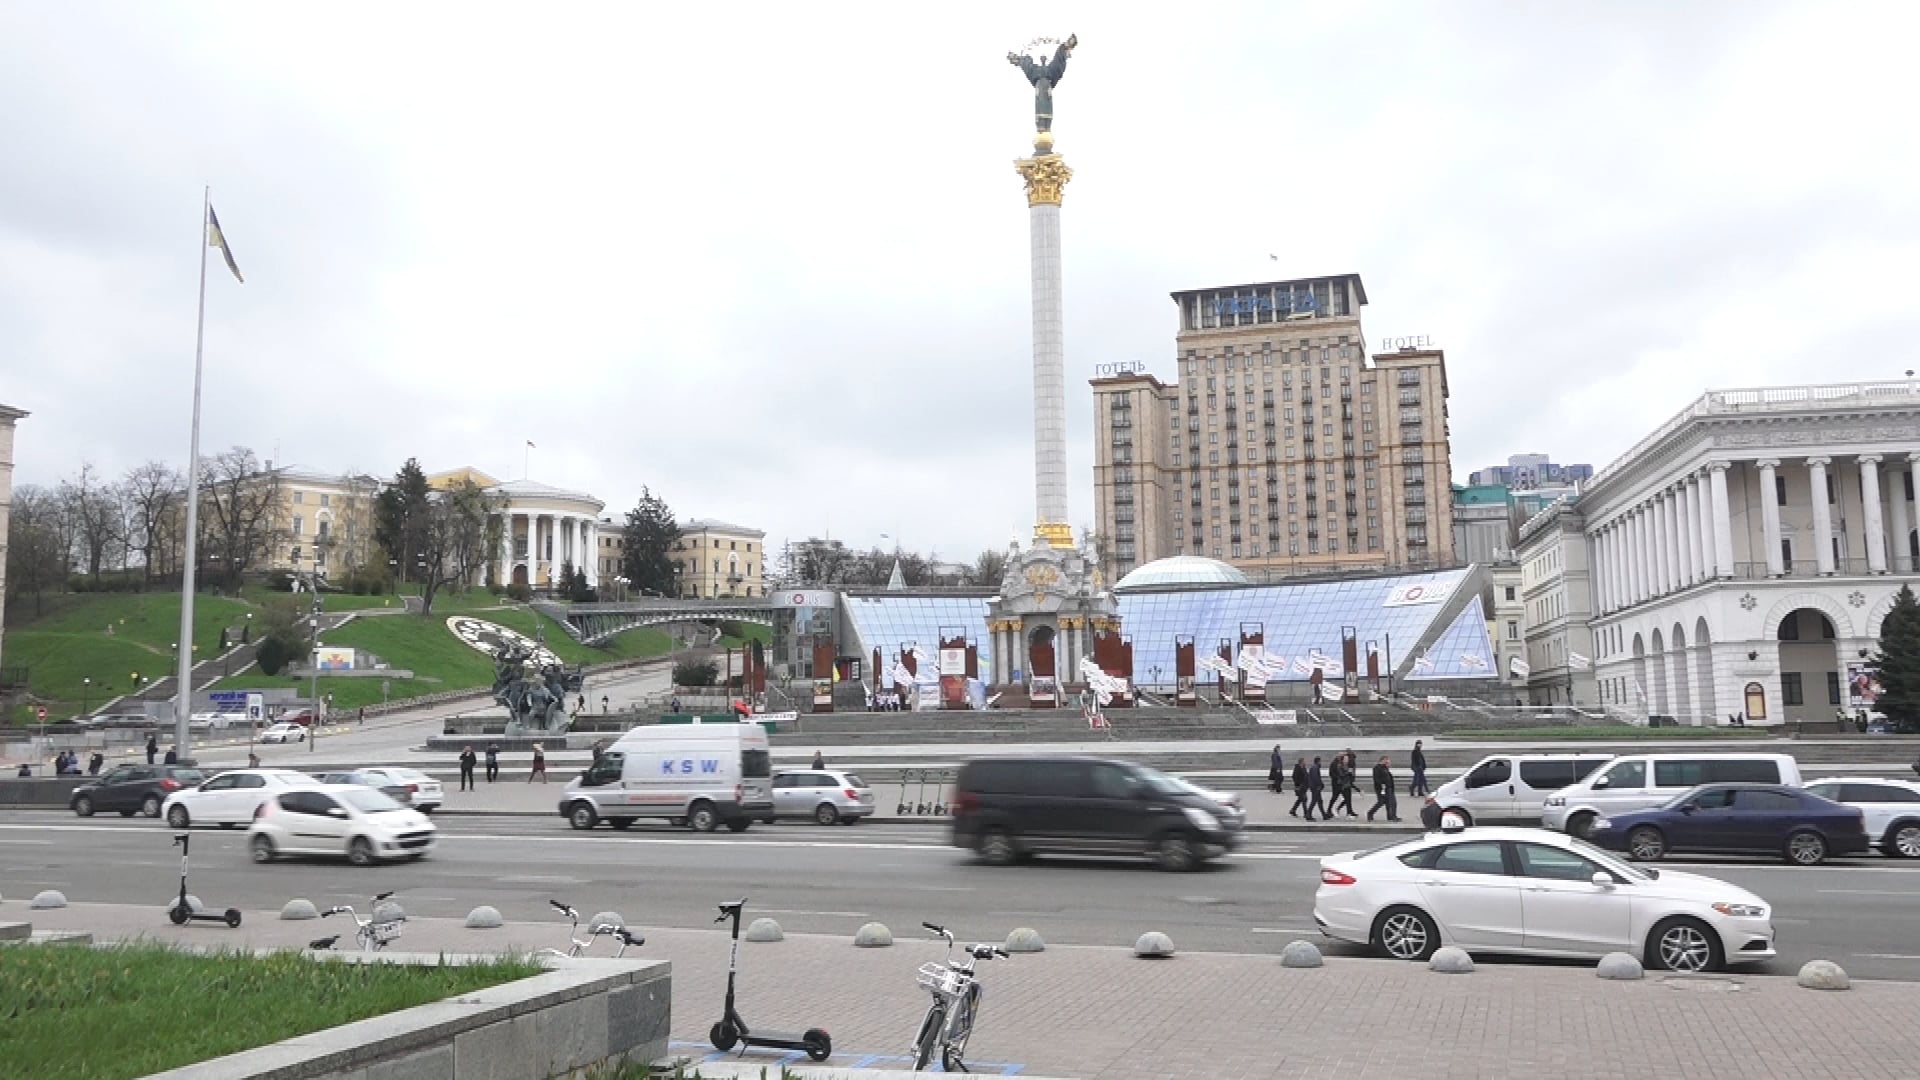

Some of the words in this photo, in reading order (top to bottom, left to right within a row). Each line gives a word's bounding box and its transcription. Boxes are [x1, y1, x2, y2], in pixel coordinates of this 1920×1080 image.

[1382, 335, 1435, 350] HOTEL
[1096, 360, 1146, 375] ГОТЕЛЬ
[661, 759, 718, 774] KSW
